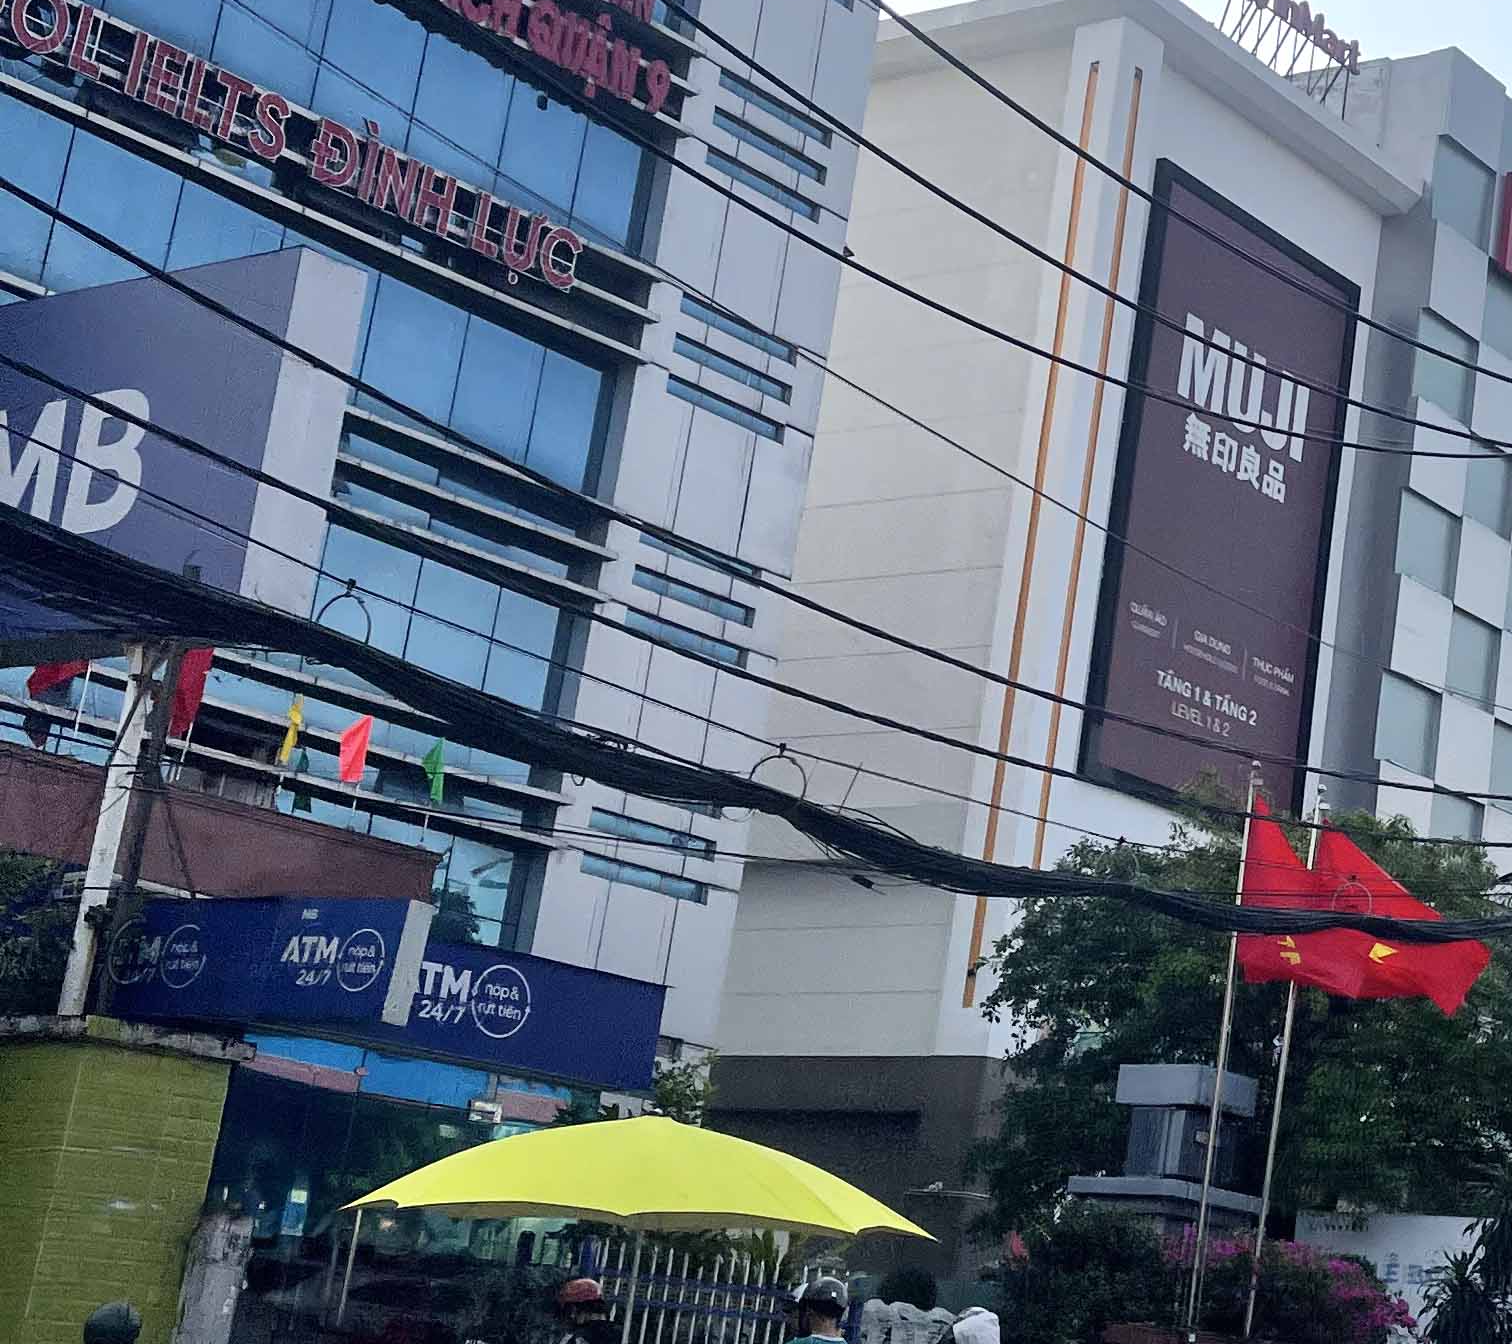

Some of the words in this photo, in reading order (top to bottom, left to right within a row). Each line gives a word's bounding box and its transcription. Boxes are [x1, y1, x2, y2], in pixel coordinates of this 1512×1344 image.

[645, 59, 672, 113] 9
[123, 30, 292, 161] IELTS
[311, 115, 457, 238] ĐÌNH
[472, 191, 584, 290] LỰC
[1177, 312, 1310, 463] MUJI
[0, 388, 150, 534] MB
[1183, 412, 1287, 504] 無印良品
[1156, 669, 1191, 697] TẦNG
[1194, 686, 1200, 702] 1
[1202, 689, 1212, 706] &
[1215, 694, 1248, 721] TẦNG
[1249, 710, 1258, 726] 2
[1171, 701, 1203, 726] LEVEL
[1206, 716, 1211, 729] 1
[1213, 718, 1221, 734] &
[1223, 722, 1233, 737] 2
[280, 935, 340, 965] ATM
[296, 968, 332, 986] 24/7
[419, 961, 472, 1003] TM
[418, 999, 468, 1024] 24/7
